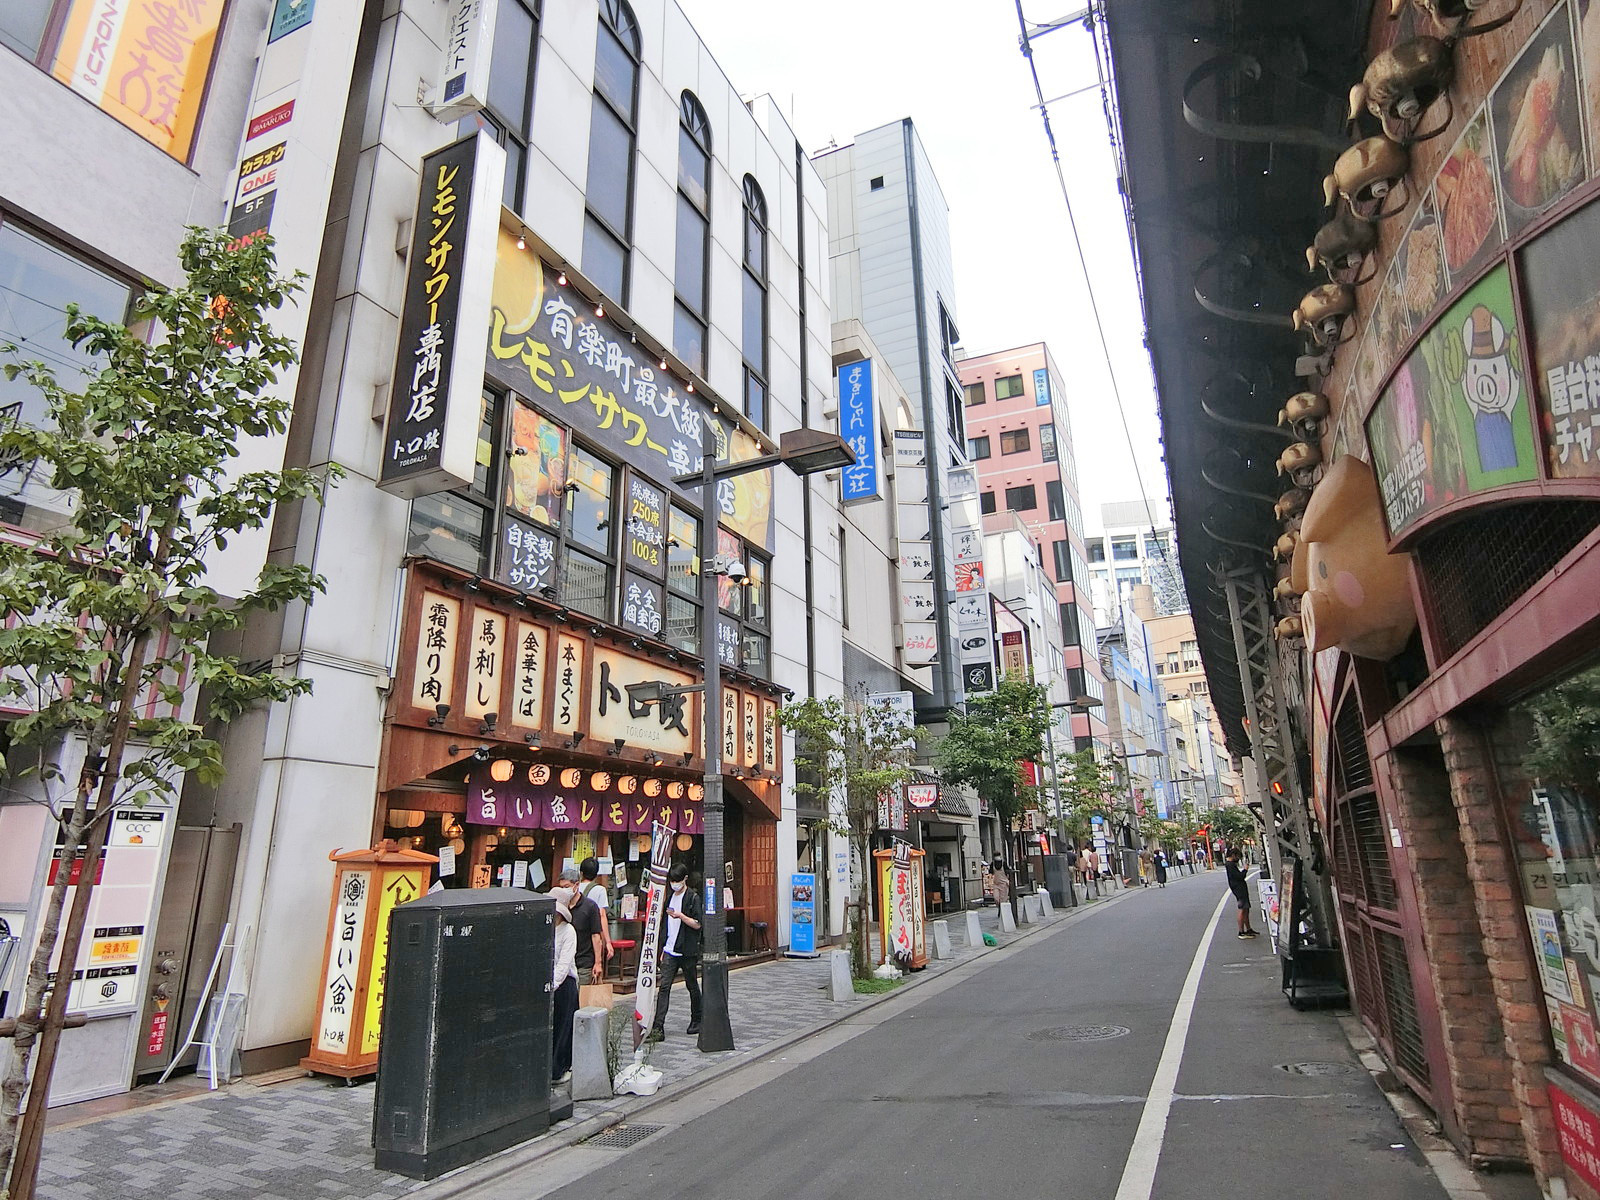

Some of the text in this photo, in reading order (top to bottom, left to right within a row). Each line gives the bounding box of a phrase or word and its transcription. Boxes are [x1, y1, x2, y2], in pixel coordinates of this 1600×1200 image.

[453, 0, 472, 70] クエスト
[241, 146, 285, 176] カラオケ
[243, 168, 277, 192] ONE
[245, 196, 264, 214] 5F
[405, 164, 460, 423] レモンサワー専門店
[545, 295, 703, 448] 有楽町最大級
[632, 499, 660, 527] 250席
[508, 523, 554, 561] 自家製
[512, 548, 550, 577] レモン
[632, 538, 658, 566] 100名
[628, 582, 656, 611] 完全
[420, 602, 450, 703] 霜降り肉
[475, 618, 496, 706] 馬刺し
[518, 631, 539, 717] 金華さば
[560, 642, 576, 725] 本まぐろ
[725, 692, 735, 758] 握り寿司
[745, 699, 754, 759] カマ焼き
[126, 823, 151, 833] CCC
[480, 788, 704, 827] 旨い魚レモンサワ
[329, 912, 357, 1015] 旨い魚
